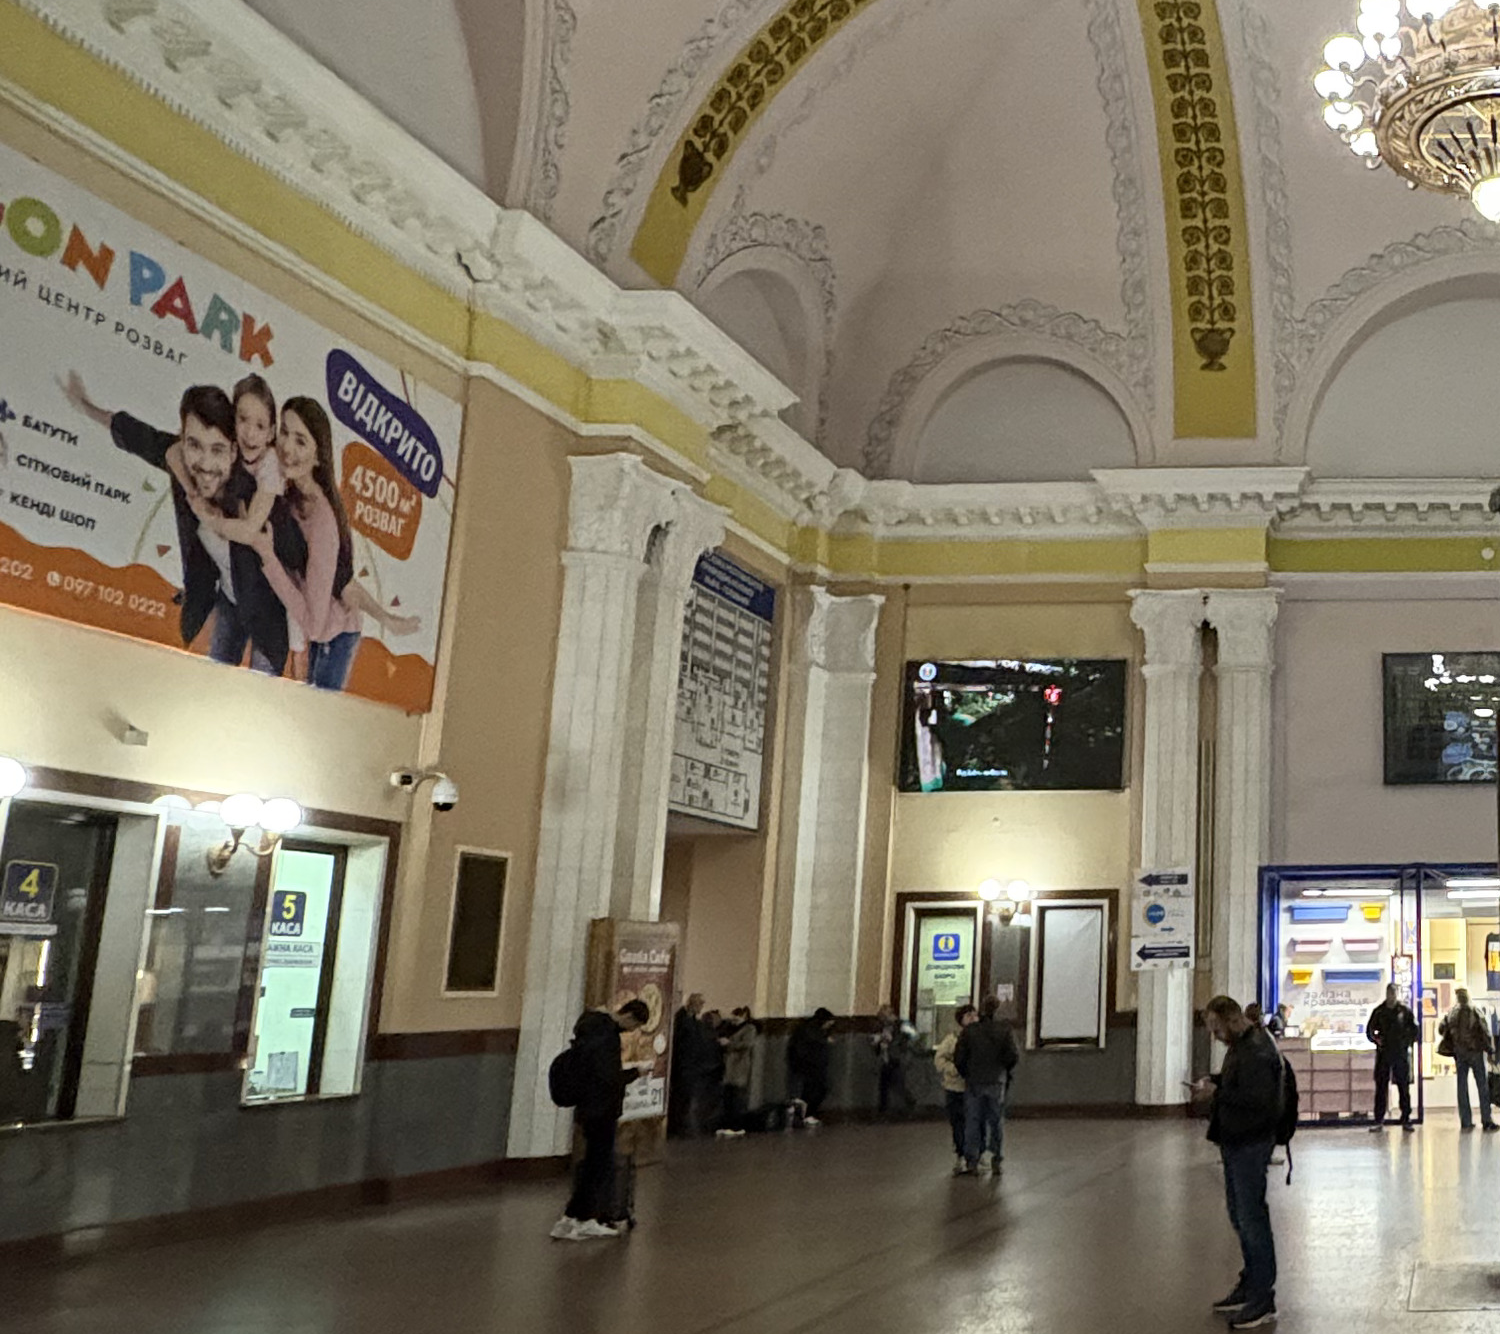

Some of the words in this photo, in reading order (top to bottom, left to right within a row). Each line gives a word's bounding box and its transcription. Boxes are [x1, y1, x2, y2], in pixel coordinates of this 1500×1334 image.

[0, 196, 115, 291] ON
[130, 250, 275, 368] PARK
[38, 284, 106, 326] ЦЕНТР
[115, 321, 188, 364] РОЗВАГ
[22, 415, 78, 446] БАТУТИ
[337, 370, 436, 482] ВІДКРИТО
[16, 454, 91, 491] СІТКОВИЙ
[94, 482, 131, 504] ПАРК
[350, 465, 399, 509] 4500
[10, 492, 55, 518] КЕНДІ
[60, 509, 96, 531] ШОП
[354, 500, 405, 537] РОЗВАГ
[64, 575, 94, 597] 097
[99, 584, 125, 606] 102
[129, 593, 167, 617] 0222
[19, 868, 40, 898] 4
[3, 900, 46, 917] КАСА
[282, 894, 297, 920] 5
[271, 921, 301, 935] КАСА
